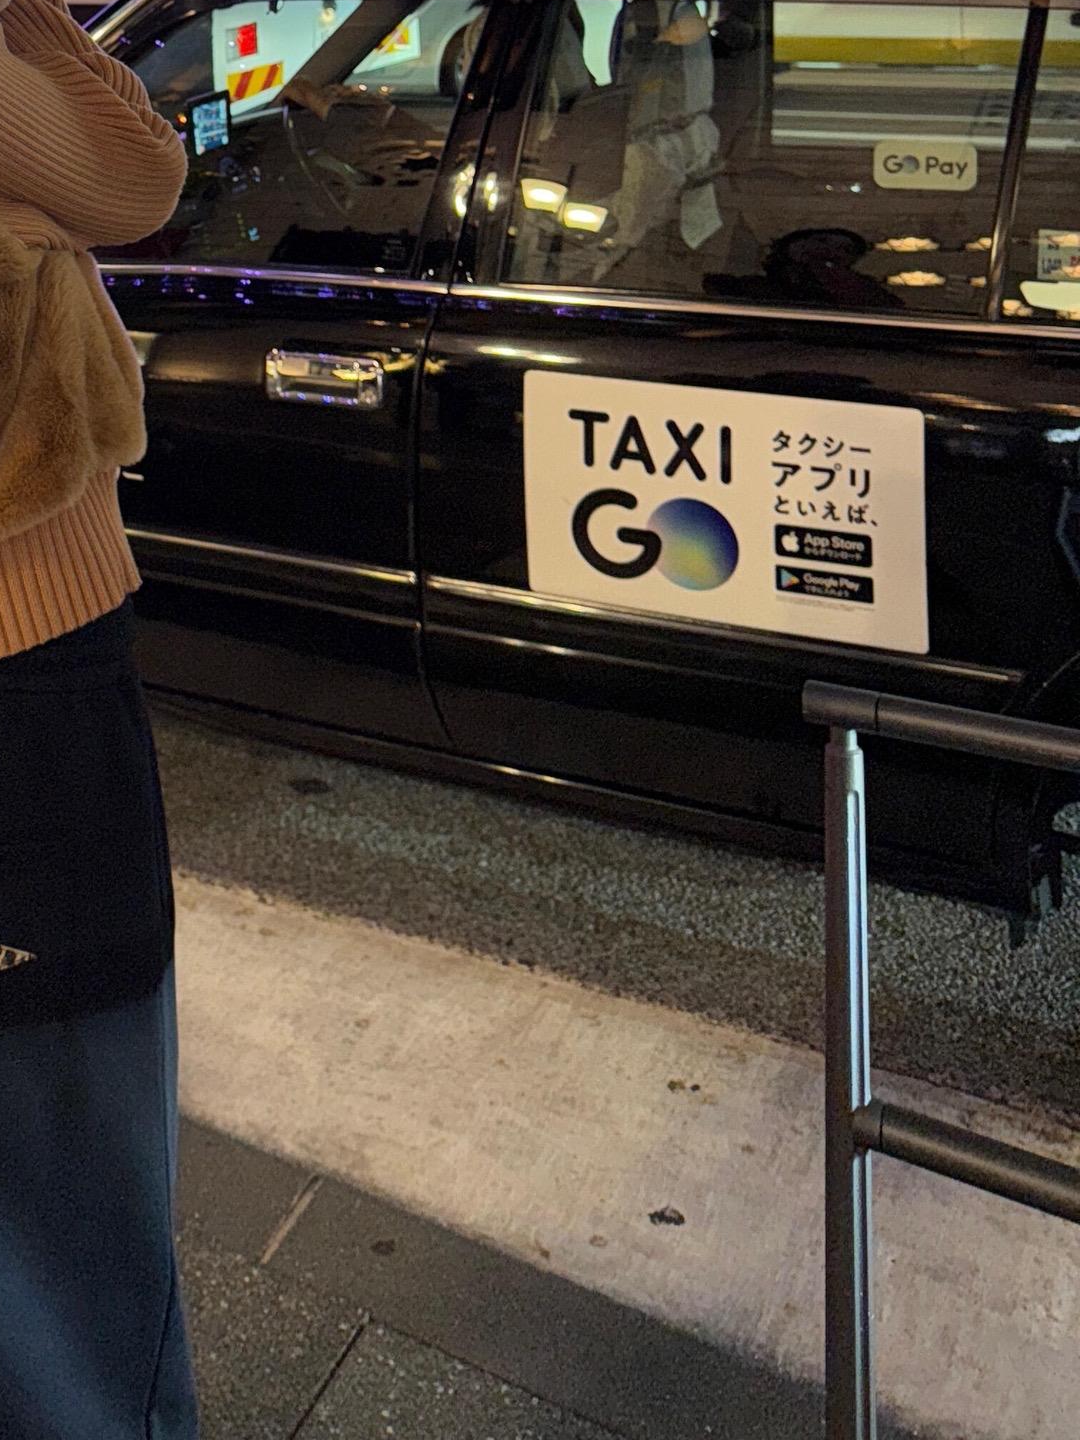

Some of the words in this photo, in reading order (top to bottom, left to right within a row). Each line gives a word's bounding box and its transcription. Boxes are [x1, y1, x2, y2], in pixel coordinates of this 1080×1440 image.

[925, 155, 968, 180] Pay
[568, 408, 733, 485] TAXI
[772, 429, 872, 458] タクシー
[771, 461, 871, 499] アプリ
[804, 532, 830, 548] App
[832, 535, 865, 552] Store
